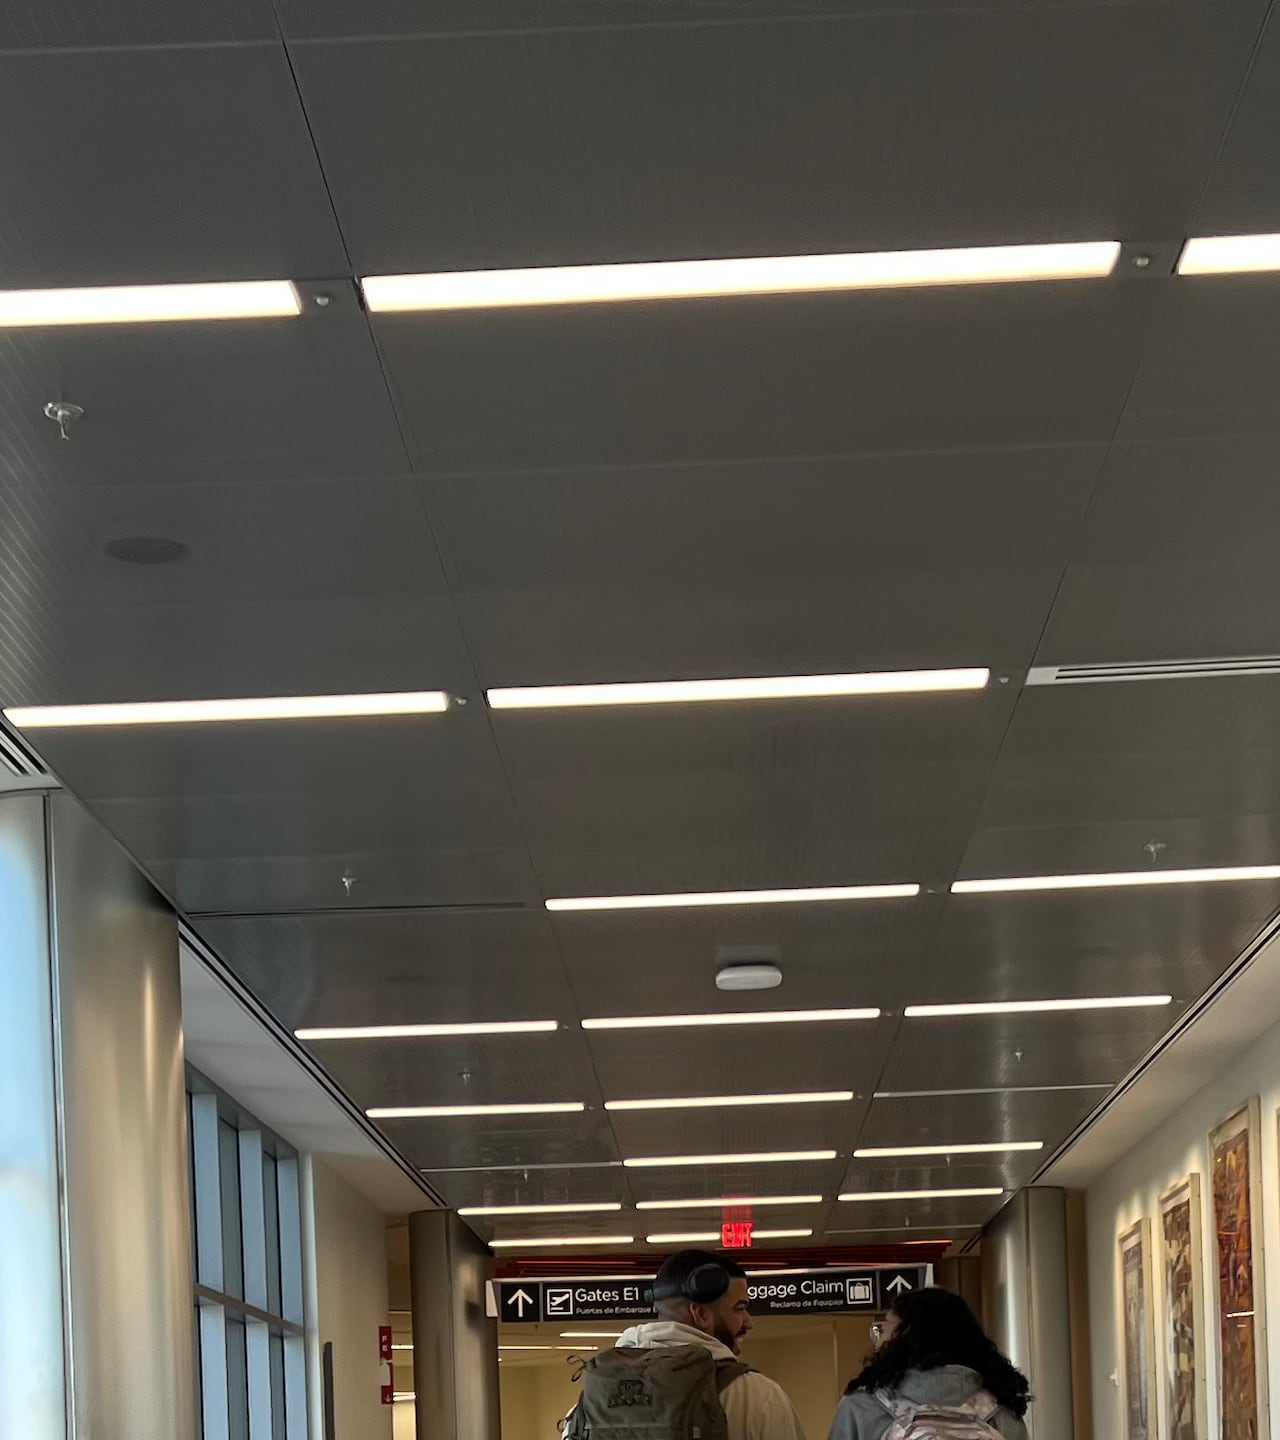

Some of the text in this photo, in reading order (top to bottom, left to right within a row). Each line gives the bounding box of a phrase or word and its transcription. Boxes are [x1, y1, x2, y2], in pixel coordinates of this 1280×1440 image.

[722, 1223, 752, 1247] EXIT
[575, 1287, 639, 1302] Gates E1
[747, 1280, 844, 1300] ggage Claim
[576, 1307, 603, 1315] Puertas
[604, 1306, 614, 1314] de
[615, 1306, 651, 1314] Embarque
